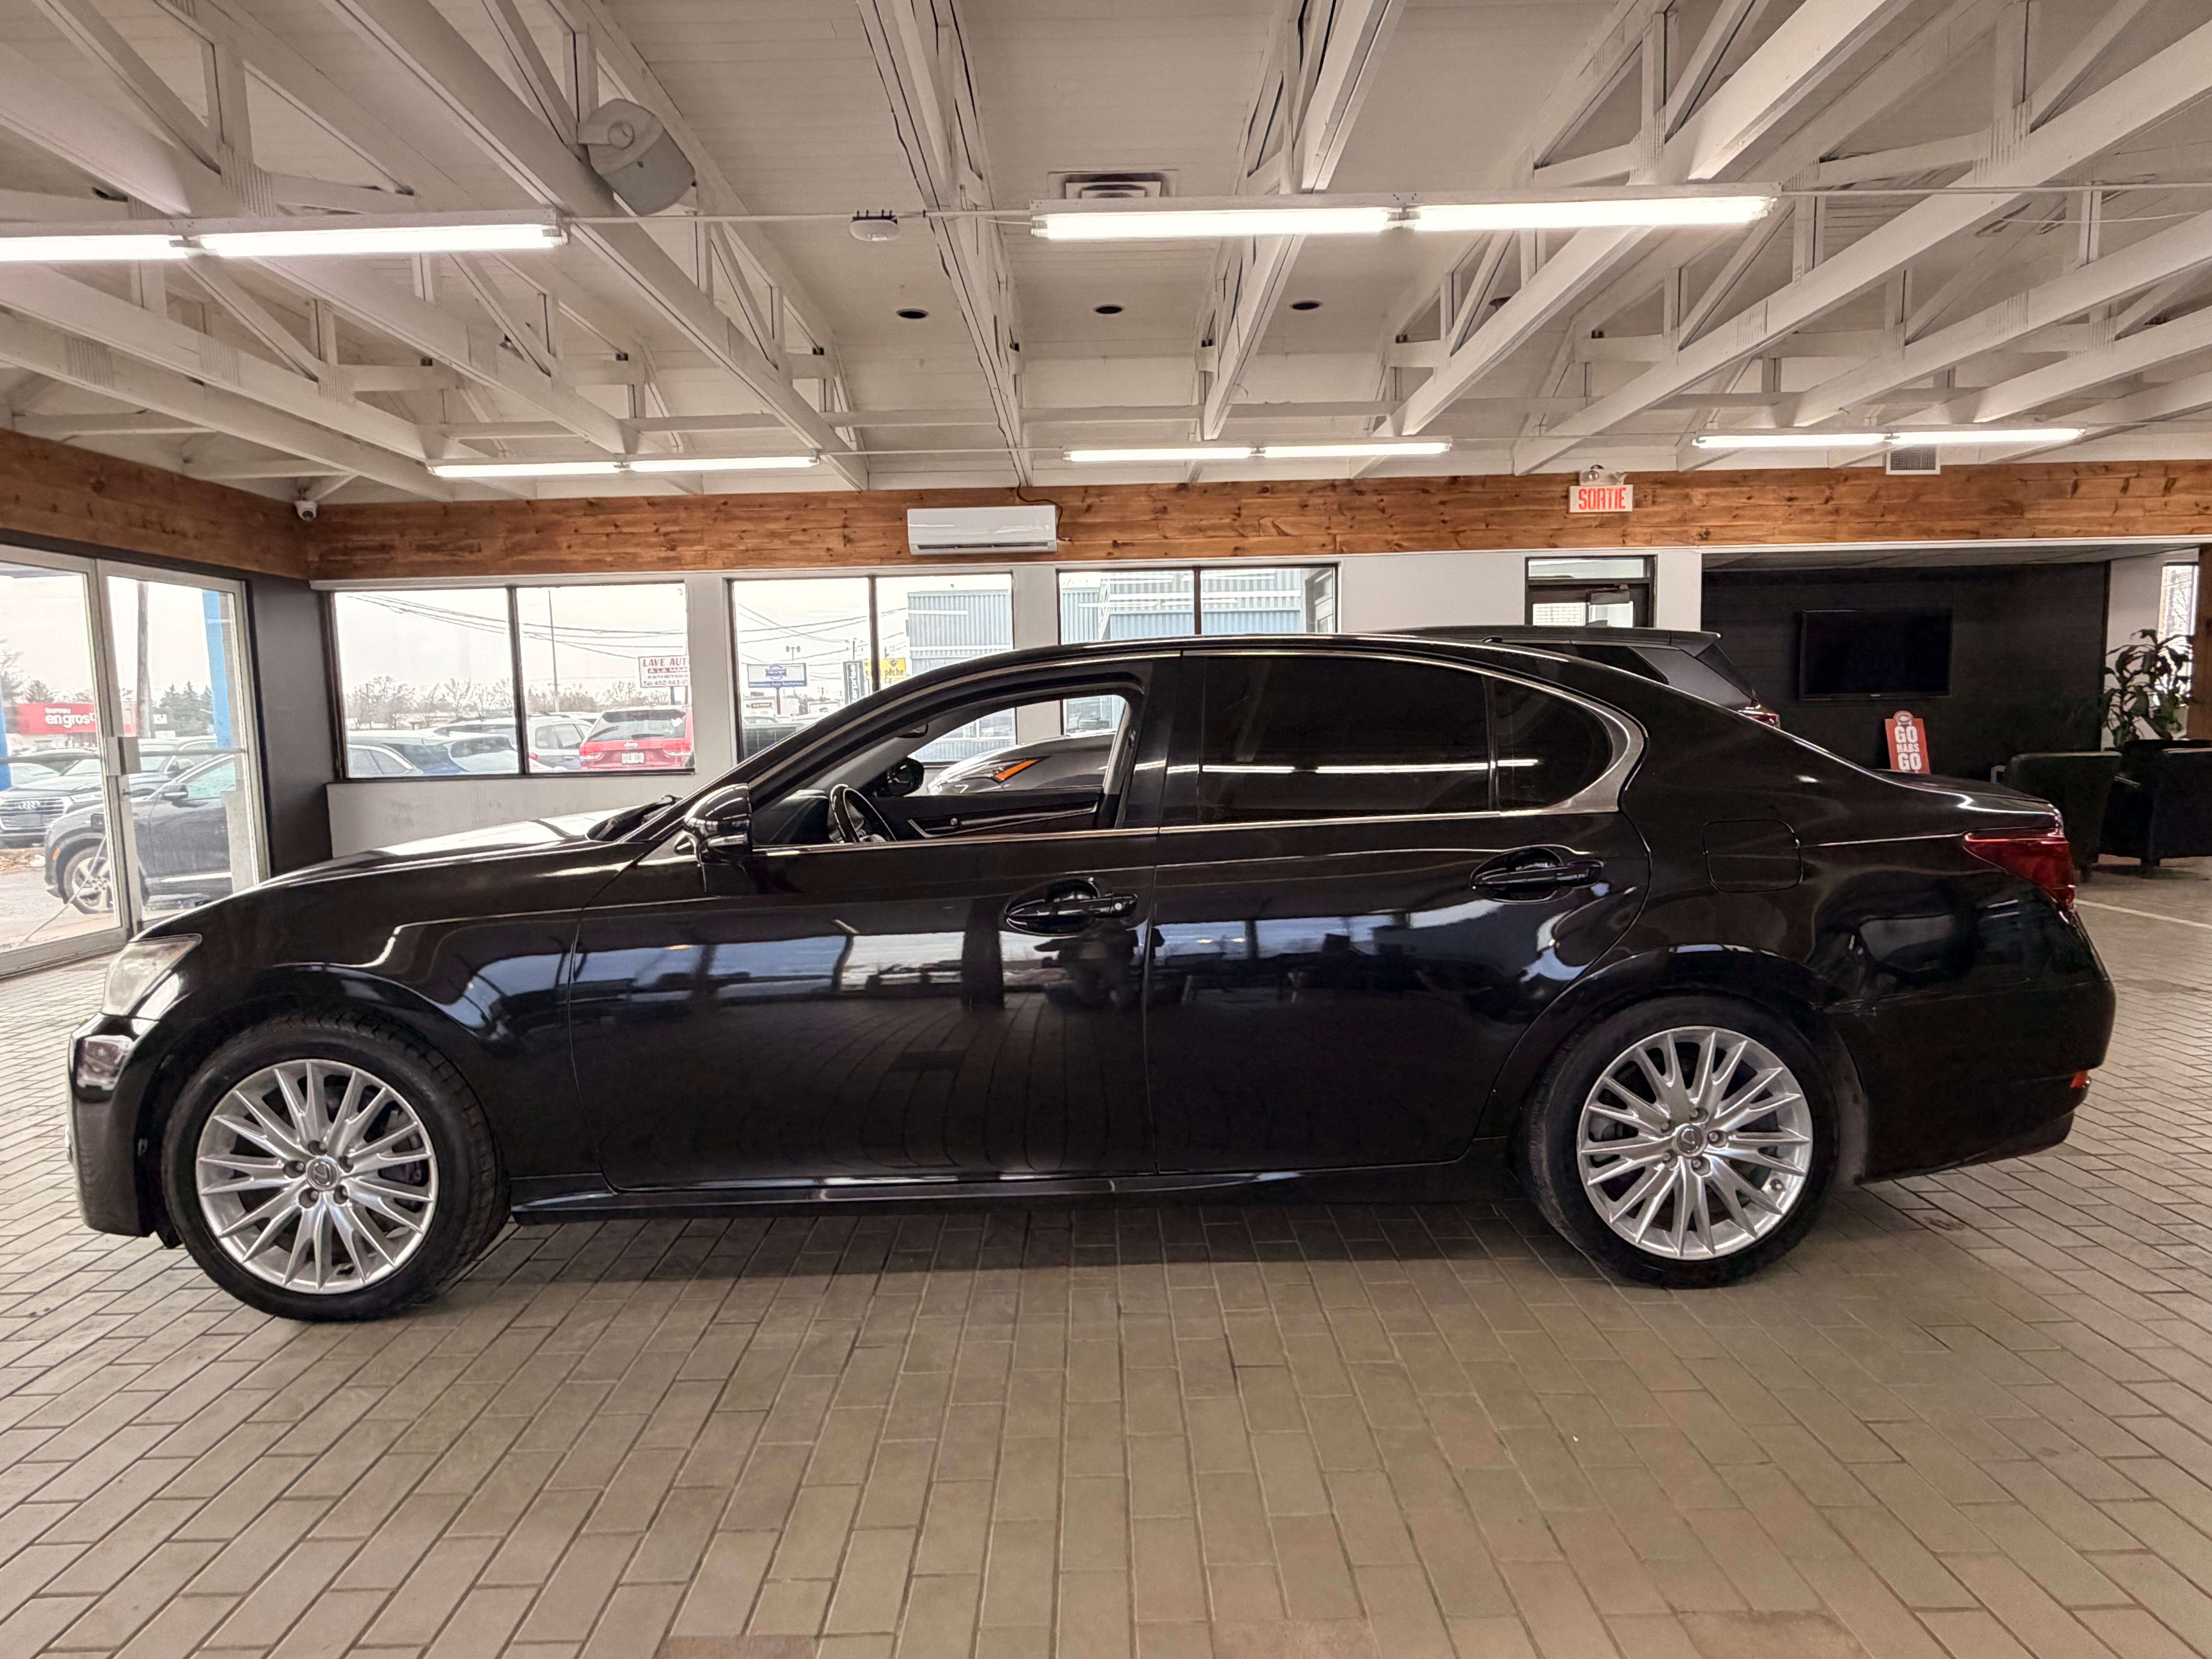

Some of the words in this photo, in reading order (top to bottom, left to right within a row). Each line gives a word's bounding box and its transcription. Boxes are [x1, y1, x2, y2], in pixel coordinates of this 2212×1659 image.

[1578, 487, 1626, 510] SORTIE
[643, 658, 665, 667] LAVE
[669, 658, 687, 666] AUT
[1894, 726, 1918, 743] GO
[1896, 743, 1920, 753] HABS
[1898, 753, 1922, 771] GO
